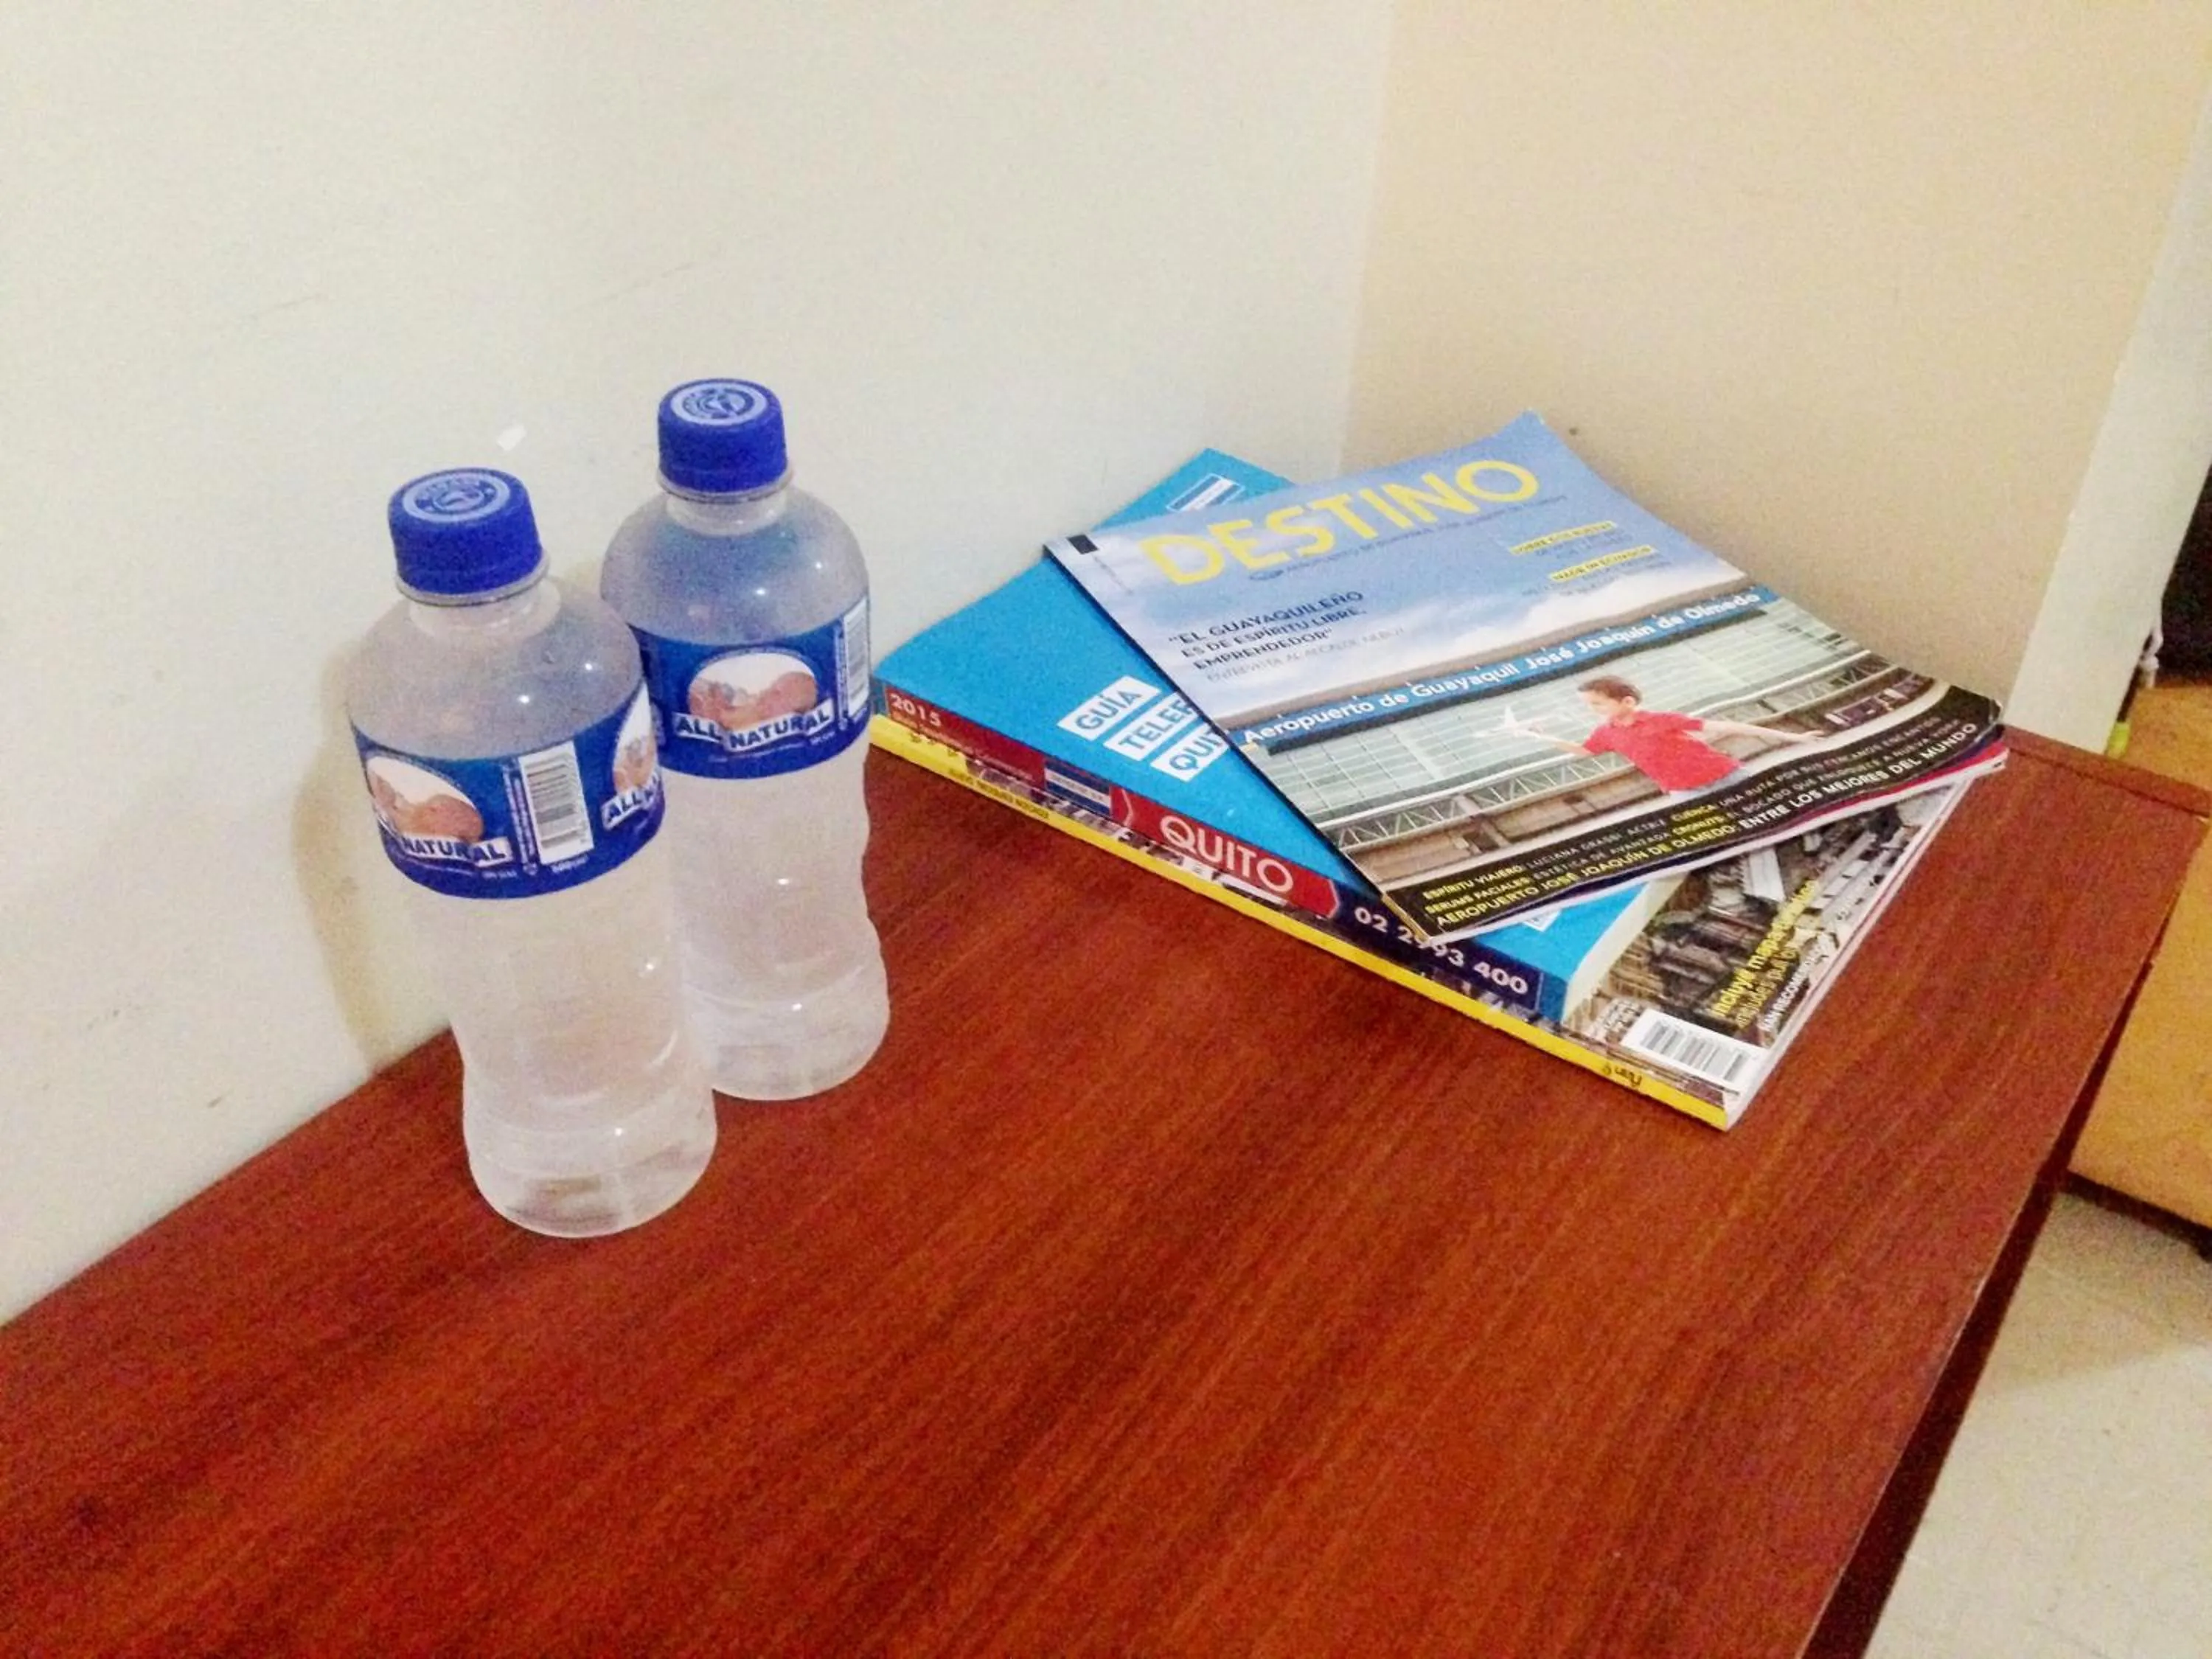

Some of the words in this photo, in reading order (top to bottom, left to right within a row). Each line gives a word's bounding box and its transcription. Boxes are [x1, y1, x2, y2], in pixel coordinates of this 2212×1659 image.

[1138, 459, 1539, 585] DESTINO
[1208, 591, 1364, 637] GUAYAQUILEÑO
[1180, 645, 1205, 658] ES
[1206, 639, 1230, 652] DE
[1243, 702, 1374, 744] Aeropuerto
[1379, 692, 1410, 708] de
[1411, 662, 1520, 698] Guayaquil
[1525, 647, 1575, 671] José
[1575, 624, 1656, 655] Joaquín
[1656, 613, 1685, 630] de
[1685, 591, 1761, 620] Olmedo
[676, 716, 722, 740] ALL
[729, 709, 831, 748] NATURAL
[889, 692, 942, 727] 2015
[1075, 690, 1142, 730] GUÍA
[607, 790, 644, 824] ALL
[1437, 885, 1540, 927] AEROPUERTO
[1540, 871, 1580, 891] JOSÉ
[1581, 848, 1649, 877] JOAQUÍN
[1649, 841, 1673, 857] DE
[1738, 804, 1791, 829] ENTRE
[1789, 789, 1823, 808] LOS
[1821, 769, 1891, 793] MEJORES
[1888, 757, 1921, 776] DEL
[1920, 722, 1978, 761] MUNDO
[402, 836, 507, 862] NATURAL
[1160, 814, 1293, 893] QUITO
[1354, 906, 1388, 933] 02
[1472, 961, 1528, 994] 400
